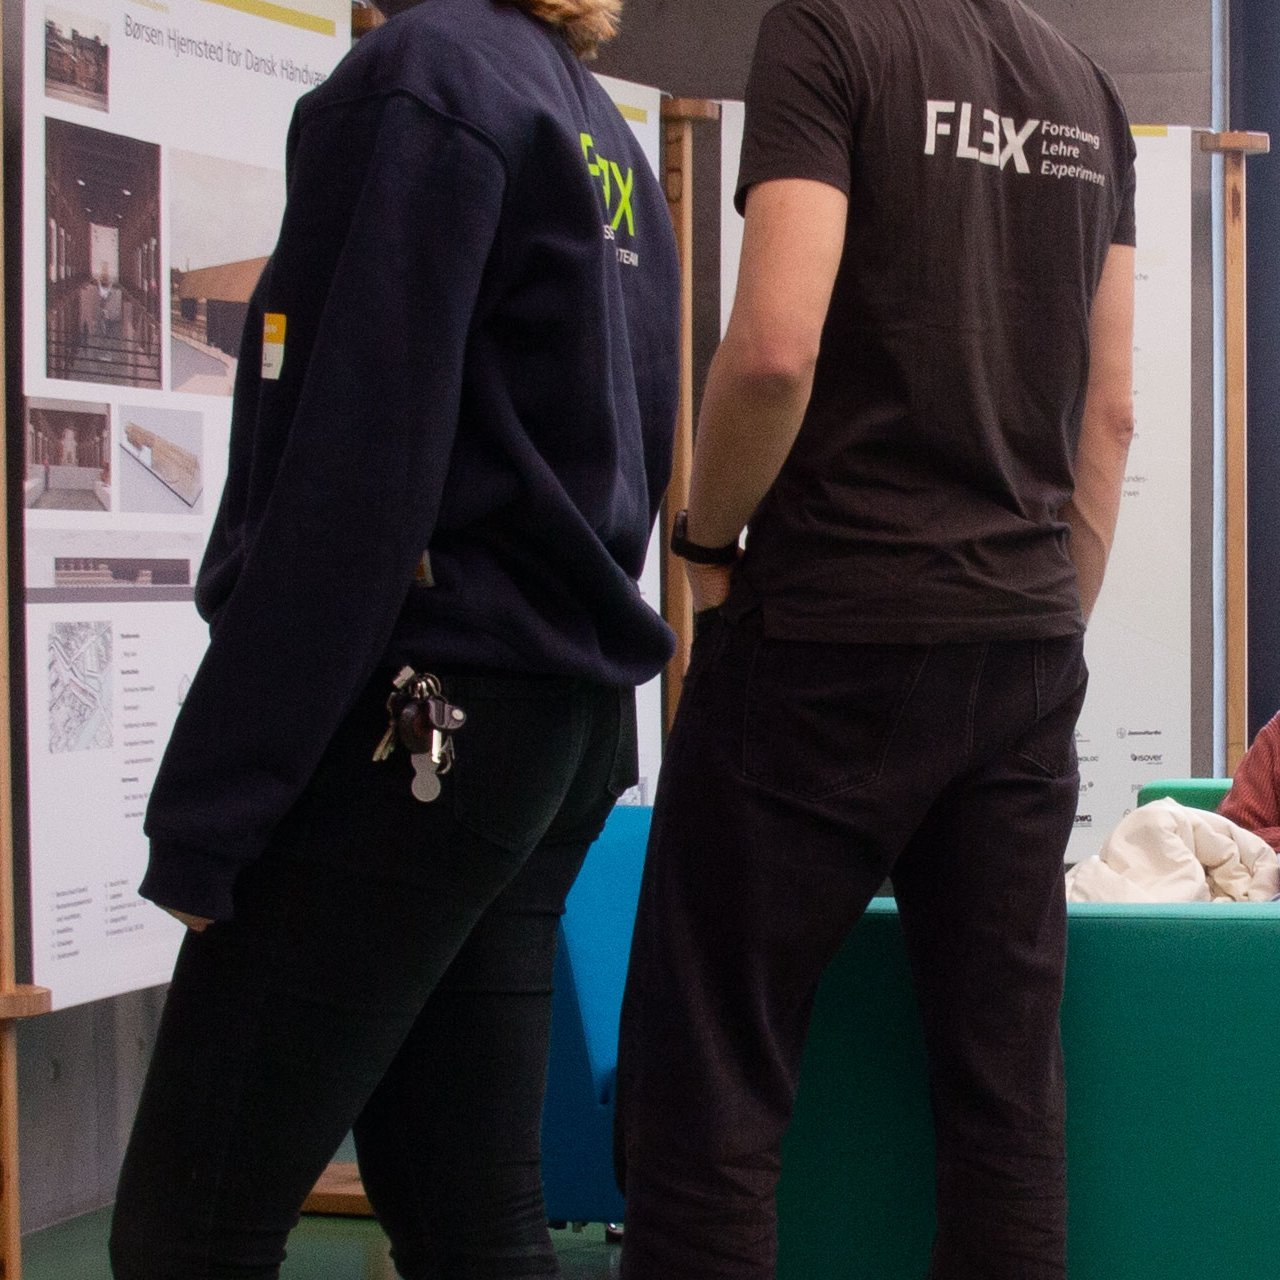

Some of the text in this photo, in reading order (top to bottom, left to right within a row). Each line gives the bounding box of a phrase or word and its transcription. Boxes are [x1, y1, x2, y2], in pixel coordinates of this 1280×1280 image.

[167, 28, 223, 62] Hjemsted
[245, 48, 278, 77] Dansk
[1042, 120, 1100, 150] Forschung
[1042, 140, 1080, 160] Lehre
[1040, 160, 1106, 187] Experiment
